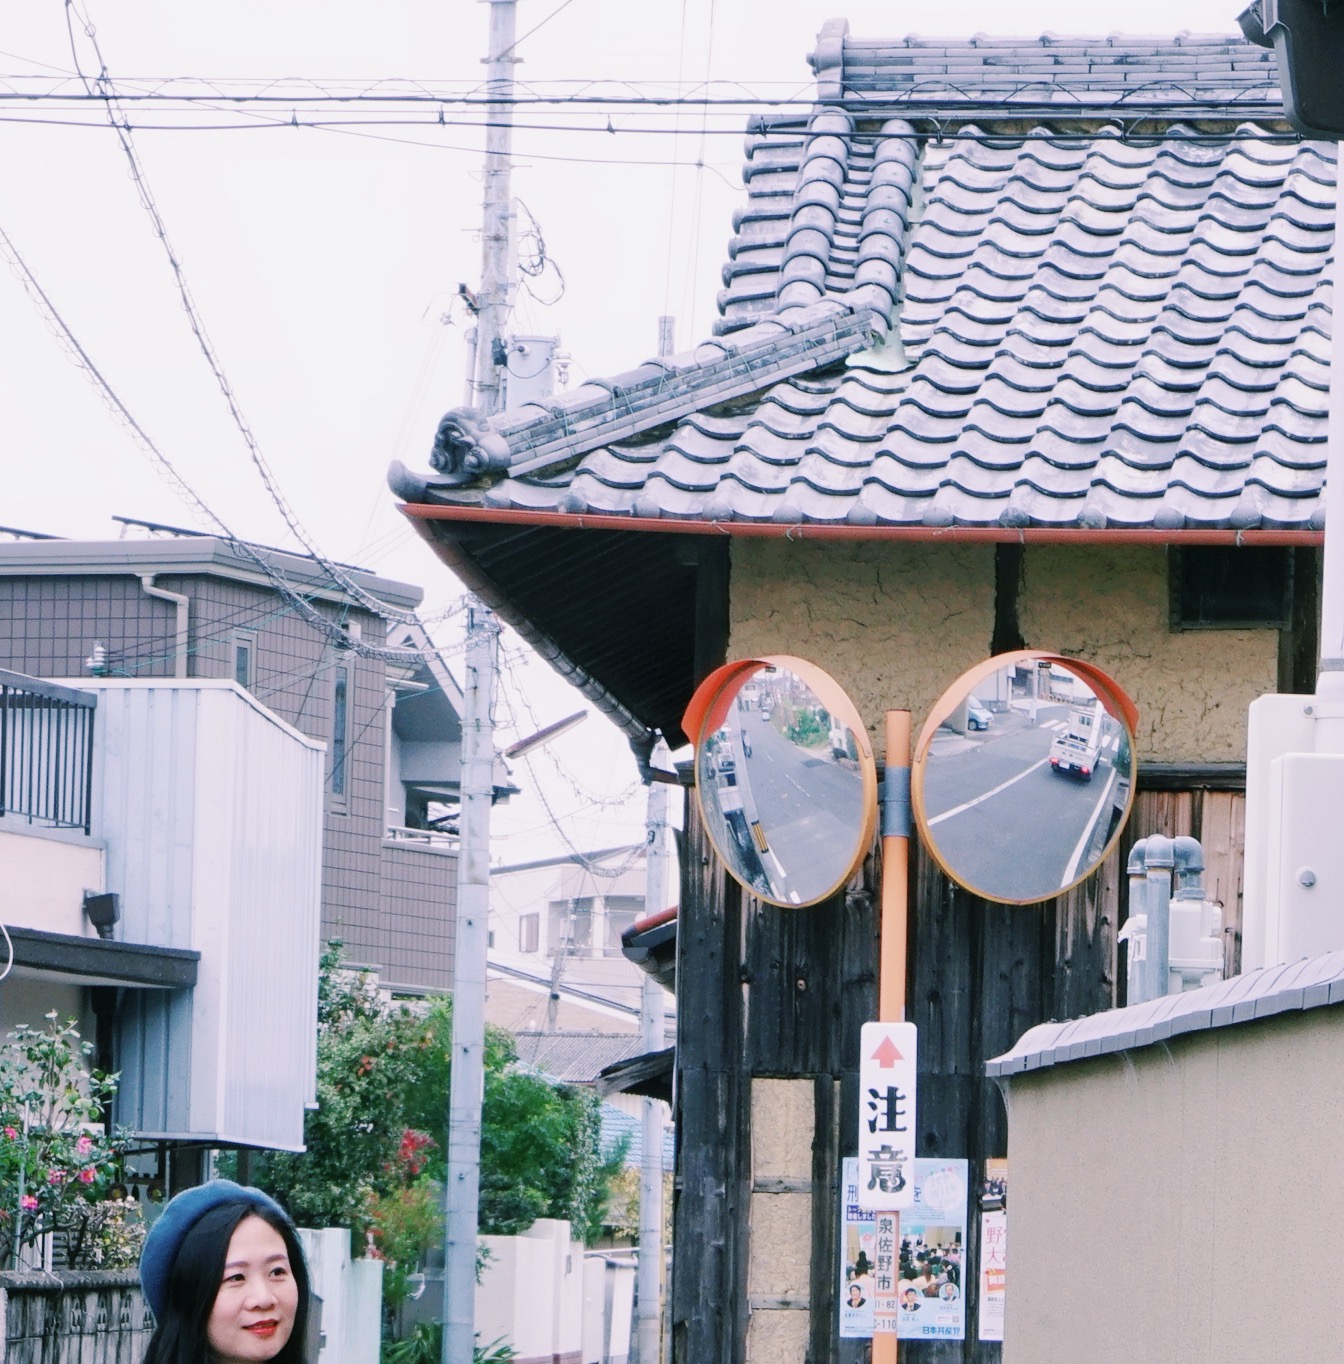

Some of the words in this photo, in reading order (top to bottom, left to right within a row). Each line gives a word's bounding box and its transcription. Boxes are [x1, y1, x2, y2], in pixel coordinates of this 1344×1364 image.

[867, 1085, 908, 1194] 注意
[877, 1217, 893, 1291] 泉佐野市
